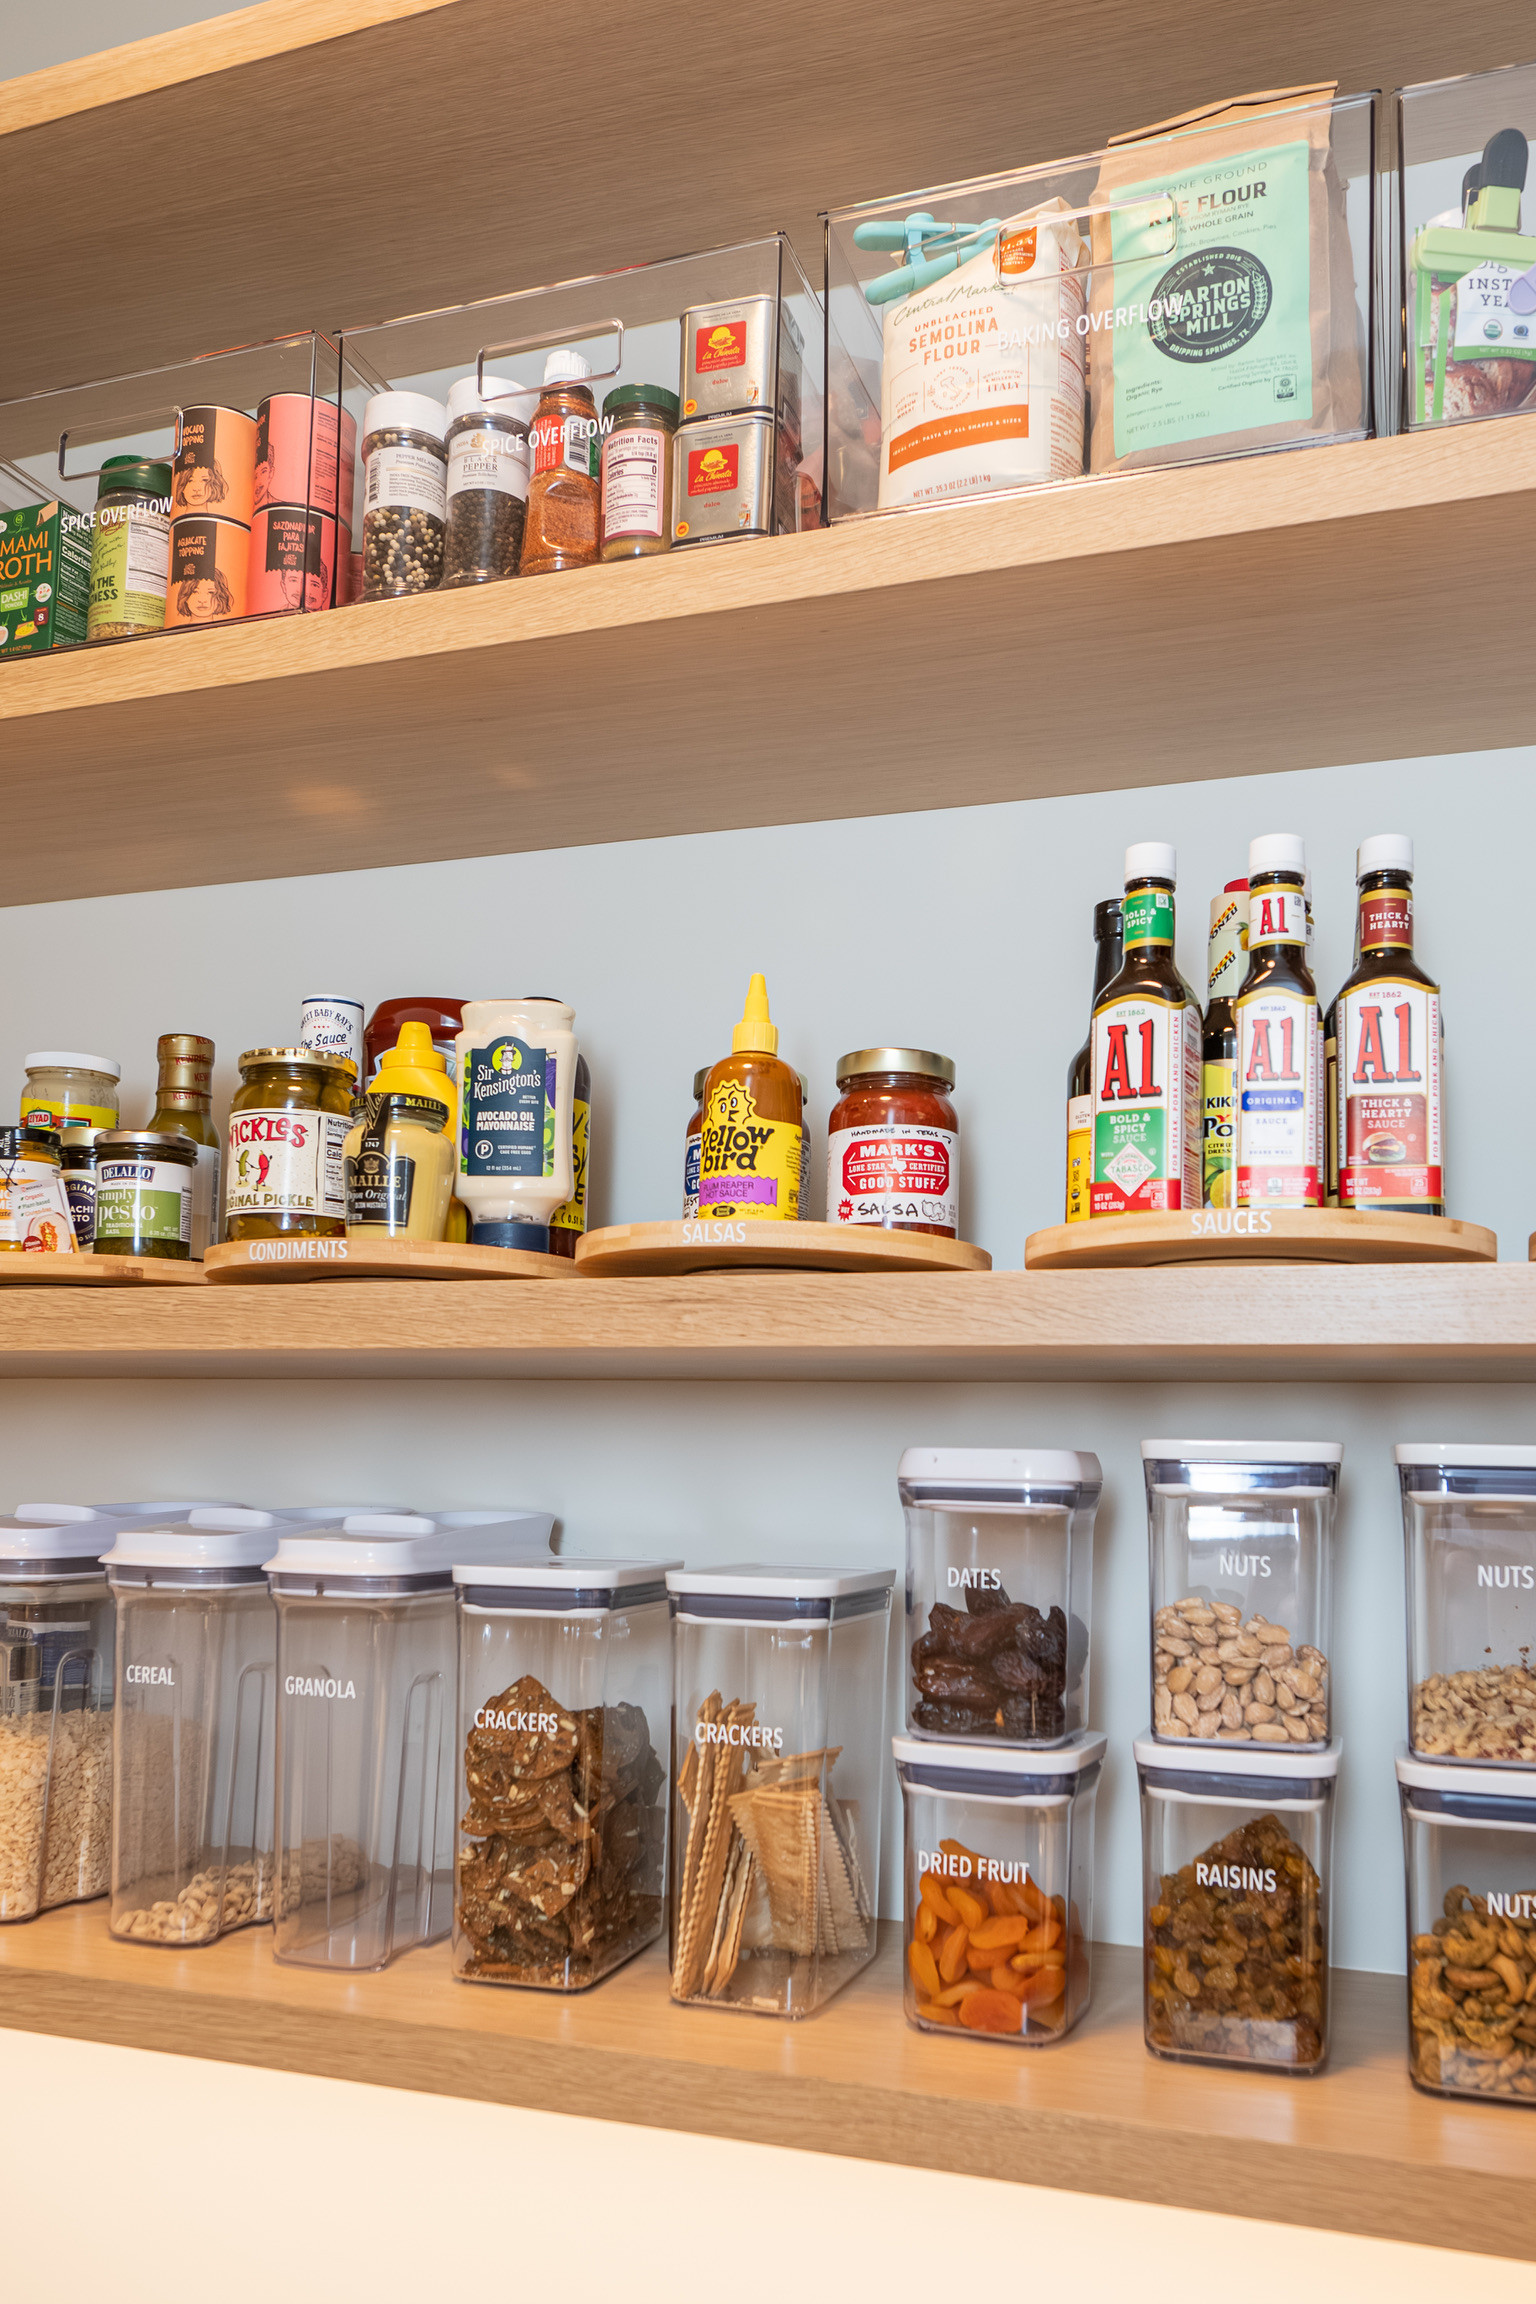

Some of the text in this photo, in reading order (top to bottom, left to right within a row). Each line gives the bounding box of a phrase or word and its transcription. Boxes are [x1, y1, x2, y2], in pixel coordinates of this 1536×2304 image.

[1203, 162, 1268, 185] GROUND
[1197, 181, 1268, 213] FLOUR
[1189, 210, 1255, 232] WHOLE GRAIN
[1175, 253, 1224, 276] ESTABLISHED
[1468, 278, 1512, 291] INST
[1481, 294, 1510, 307] YE
[1168, 292, 1251, 325] SPRINGS
[914, 306, 994, 333] UNBLEACHED
[999, 294, 1185, 351] BAKING OVERFLOW
[1186, 312, 1234, 336] MILL
[908, 317, 999, 354] SEMOLINA
[1169, 343, 1204, 357] DRIPPING
[1238, 328, 1250, 339] TX
[713, 346, 741, 359] Chinata
[923, 339, 980, 366] FLOUR
[987, 381, 1020, 393] ITALY
[1125, 386, 1163, 402] Organic Rye
[481, 433, 524, 458] SPICE
[527, 414, 615, 449] OVERFLOW
[922, 432, 942, 442] PASTA
[954, 426, 966, 434] ALL
[968, 421, 994, 431] SHAPES
[1002, 417, 1022, 425] SIZES
[608, 435, 658, 451] Nutrition Facts
[462, 462, 499, 472] PEPPER
[705, 469, 733, 482] Chinata
[912, 489, 924, 498] NET
[948, 481, 956, 490] OZ
[60, 495, 173, 534] SPICE OVERFLOW
[282, 531, 300, 542] PARA
[178, 546, 205, 558] TOPPING
[277, 542, 304, 553] FAJITAS
[96, 575, 116, 589] THE
[1, 589, 28, 604] DASHI
[37, 613, 45, 622] 8
[1149, 907, 1157, 915] &
[1260, 896, 1289, 936] A1
[1369, 912, 1402, 922] THICK
[1126, 916, 1154, 929] SPICY
[1369, 921, 1410, 931] HEARTY
[1382, 991, 1402, 999] 1862
[314, 1008, 354, 1032] BABY RAY'S
[1127, 1008, 1146, 1017] 1862
[315, 1033, 347, 1047] Sauce
[477, 1064, 495, 1082] Sir
[473, 1069, 542, 1102] Kensington's
[1246, 1096, 1298, 1106] ORIGINAL
[1361, 1098, 1412, 1108] THICK &
[28, 1114, 49, 1124] ZIYAD
[476, 1111, 535, 1122] AVOCADO OIL
[1109, 1113, 1151, 1125] BOLD &
[1361, 1108, 1412, 1119] HEARTY
[475, 1121, 535, 1132] MAYONNAISE
[1113, 1123, 1147, 1134] SPICY
[1367, 1119, 1406, 1129] SAUCE
[851, 1127, 895, 1137] HANDMADE
[916, 1129, 939, 1138] TEXAS
[1112, 1133, 1147, 1144] SAUCE
[3, 1130, 11, 1156] NATURAL
[859, 1143, 935, 1158] MARK'S
[703, 1144, 759, 1174] bird
[103, 1165, 152, 1180] DELALLO
[848, 1162, 945, 1173] LONE STAR CERTIFIED
[1111, 1163, 1150, 1174] TABASCO
[703, 1181, 754, 1192] PLUM REAPER
[859, 1176, 936, 1190] GOOD STUFF
[24, 1192, 44, 1201] Organic
[98, 1188, 135, 1204] simply
[263, 1193, 315, 1207] PICKLE
[705, 1189, 748, 1200] HOT SAUCE
[98, 1199, 156, 1228] pesto
[857, 1202, 919, 1218] SALSA
[1191, 1210, 1273, 1236] SAUCES
[682, 1222, 747, 1244] SALSAS
[249, 1239, 348, 1262] CONDIMENTS
[1218, 1554, 1272, 1579] NUTS
[946, 1565, 1002, 1590] DATES
[1476, 1564, 1534, 1589] NUTS
[126, 1663, 175, 1687] CEREAL
[284, 1674, 357, 1700] GRANOLA
[473, 1707, 559, 1734] CRACKERS
[695, 1721, 784, 1751] CRACKERS
[917, 1848, 1030, 1886] DRIED FRUIT
[1195, 1862, 1278, 1894] RAISINS
